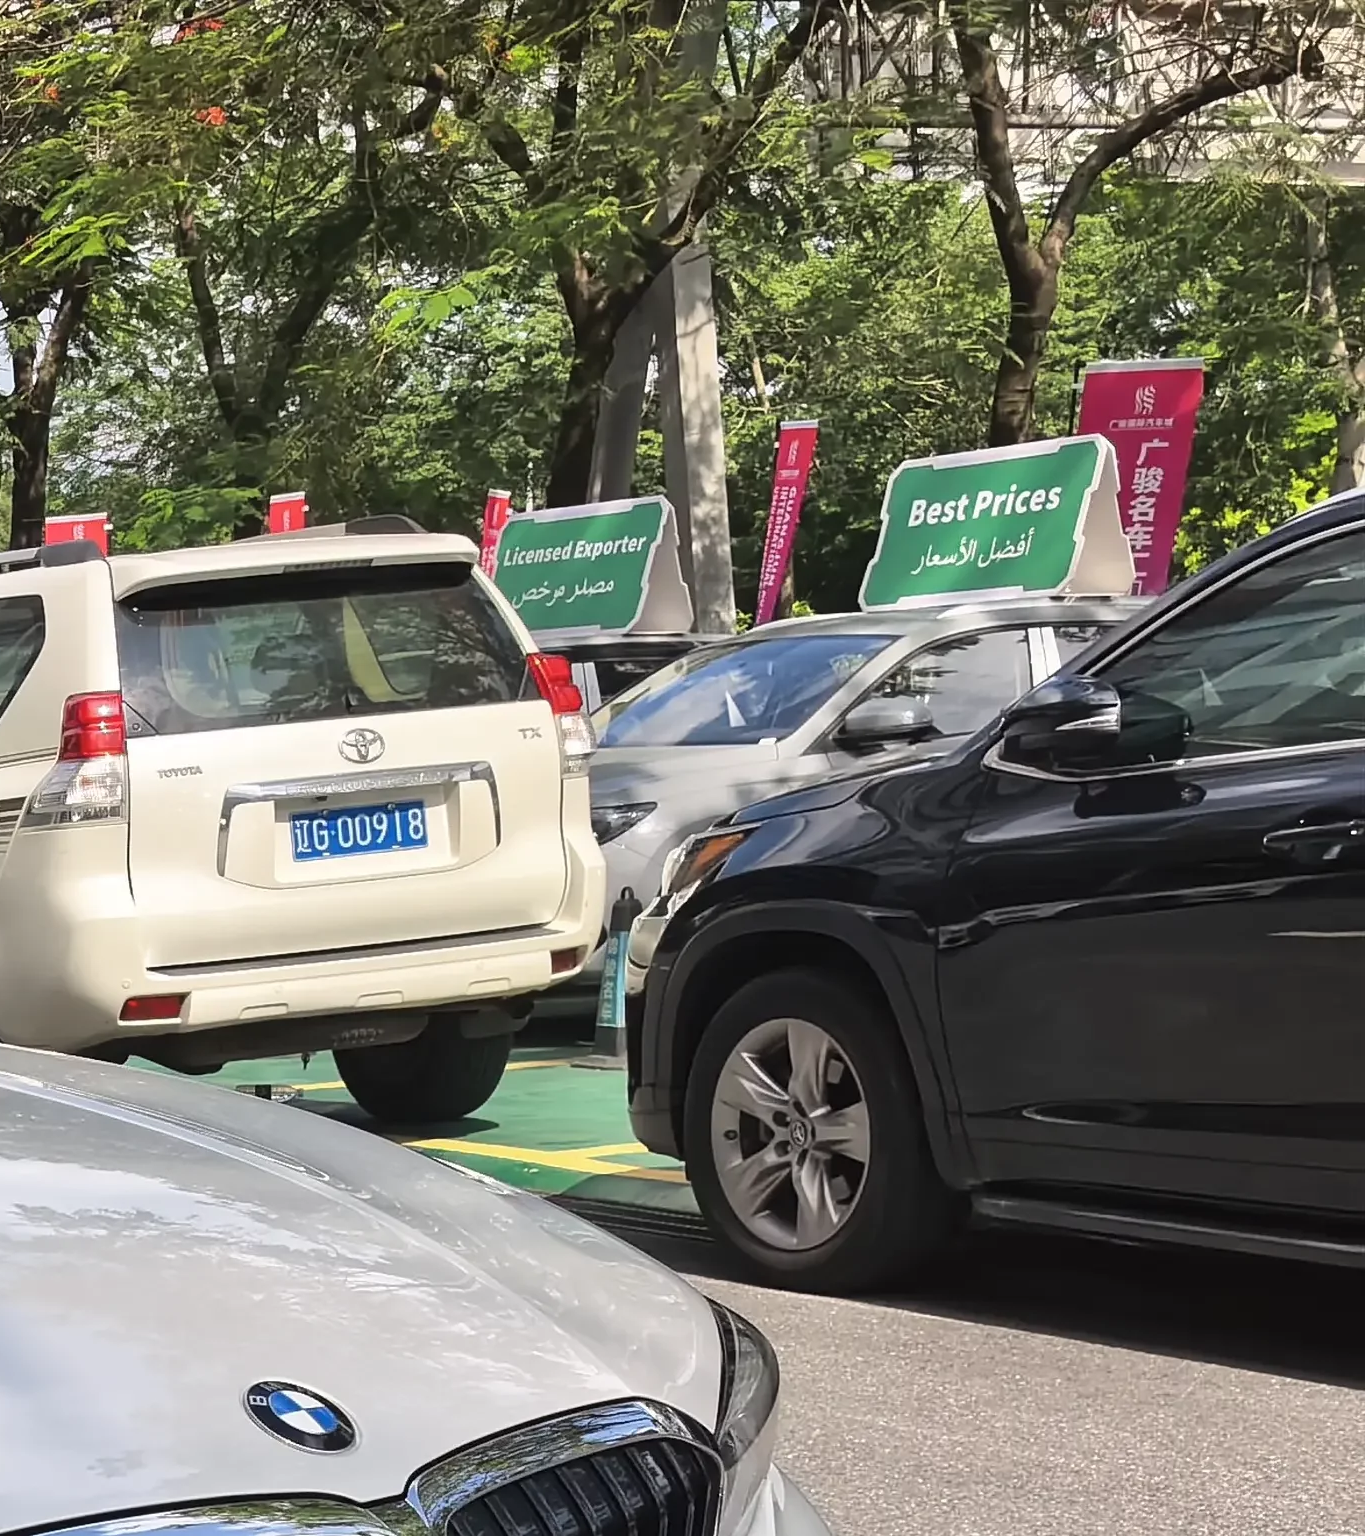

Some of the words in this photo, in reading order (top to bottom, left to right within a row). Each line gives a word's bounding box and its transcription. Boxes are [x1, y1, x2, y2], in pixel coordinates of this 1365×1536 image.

[908, 494, 969, 527] Best
[972, 484, 1062, 519] Prices
[503, 541, 573, 567] Licensed
[574, 535, 647, 561] Exporter
[910, 536, 978, 575] الأسعار
[977, 527, 1035, 568] أفضل
[518, 726, 542, 739] TX
[157, 765, 203, 780] TOYOTA
